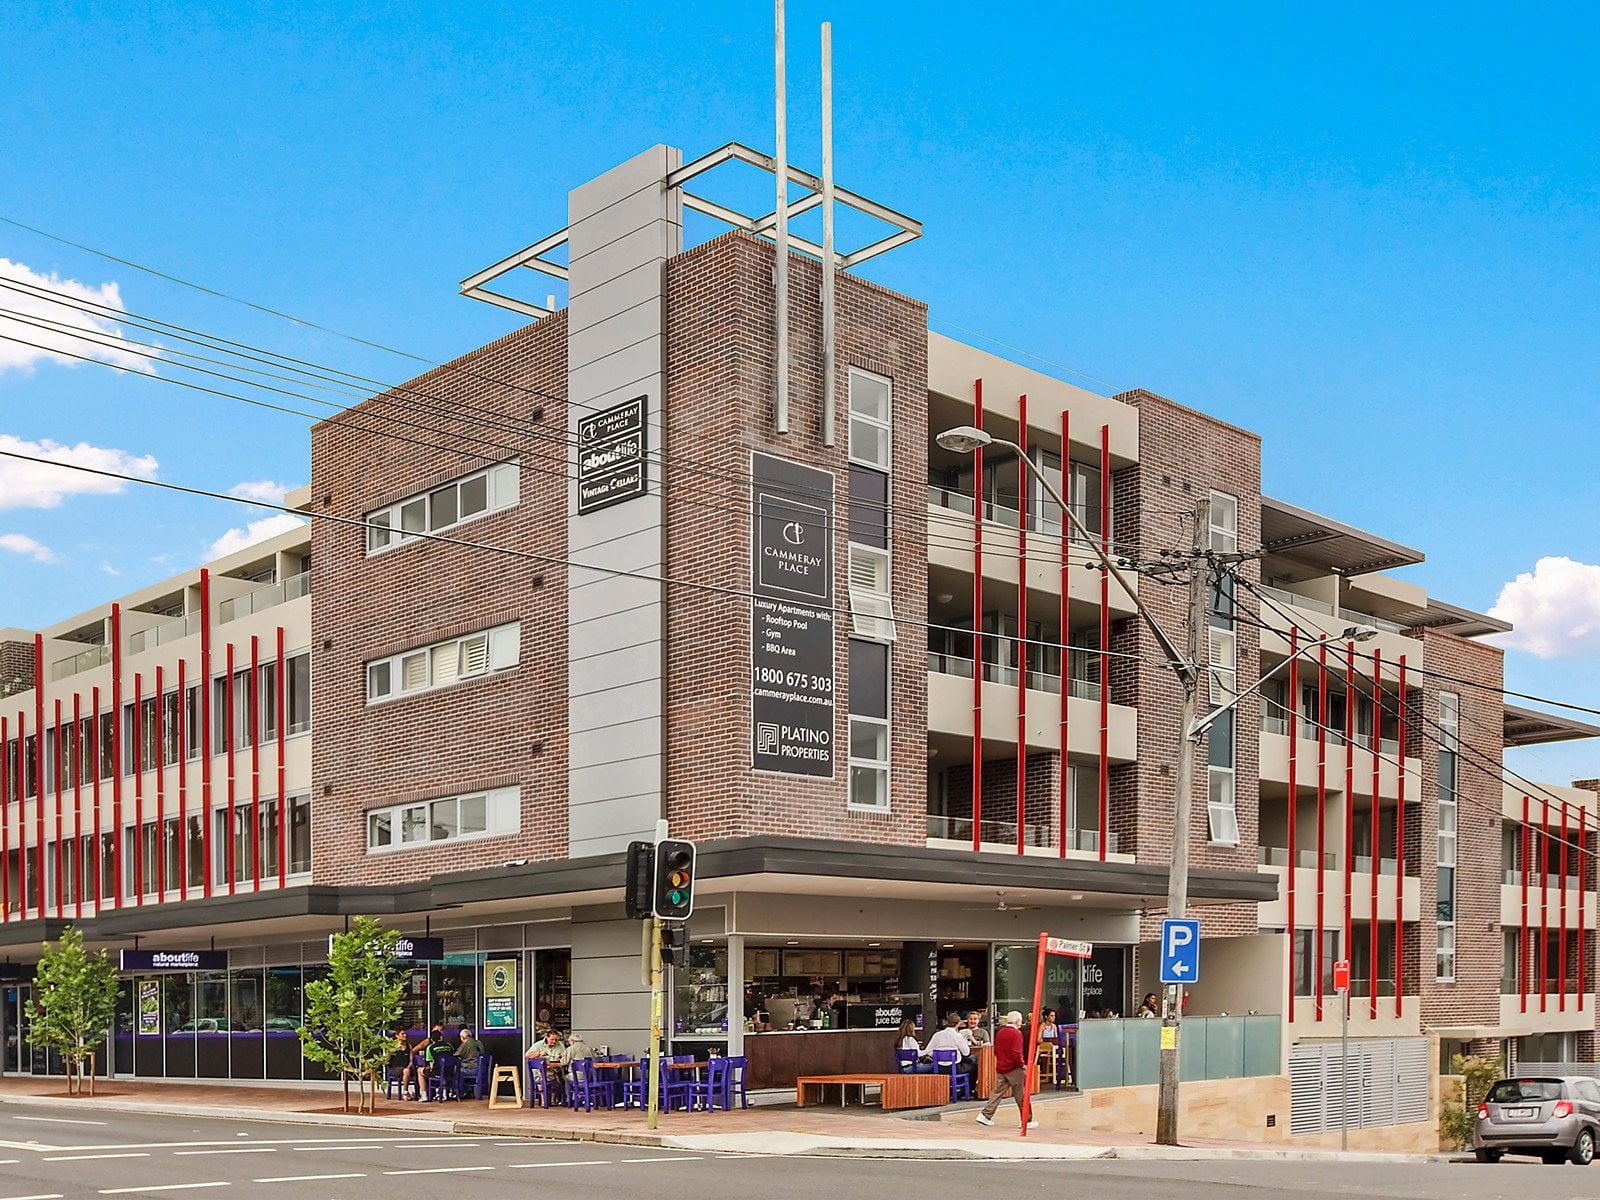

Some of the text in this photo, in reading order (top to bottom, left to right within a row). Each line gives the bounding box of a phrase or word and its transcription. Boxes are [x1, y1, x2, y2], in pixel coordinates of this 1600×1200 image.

[598, 406, 638, 427] CAMMERAY
[607, 418, 629, 433] PLACE
[764, 546, 822, 567] CAMMERAY
[778, 560, 809, 575] PLACE
[754, 598, 832, 621] Luxury Apartments with:
[766, 614, 808, 630] Rooftop Pool
[765, 628, 781, 640] Gym
[766, 643, 796, 656] BBQ Area
[754, 666, 832, 692] 1800 675 303
[754, 688, 833, 706] cammerayplace.com.au
[781, 725, 830, 745] PLATINO
[781, 745, 830, 761] PROPERTIES
[1059, 939, 1078, 950] Palmer
[1168, 925, 1193, 958] P
[152, 952, 200, 963] aboutlife
[875, 1007, 902, 1017] aboutlife
[875, 1016, 902, 1027] juice bar
